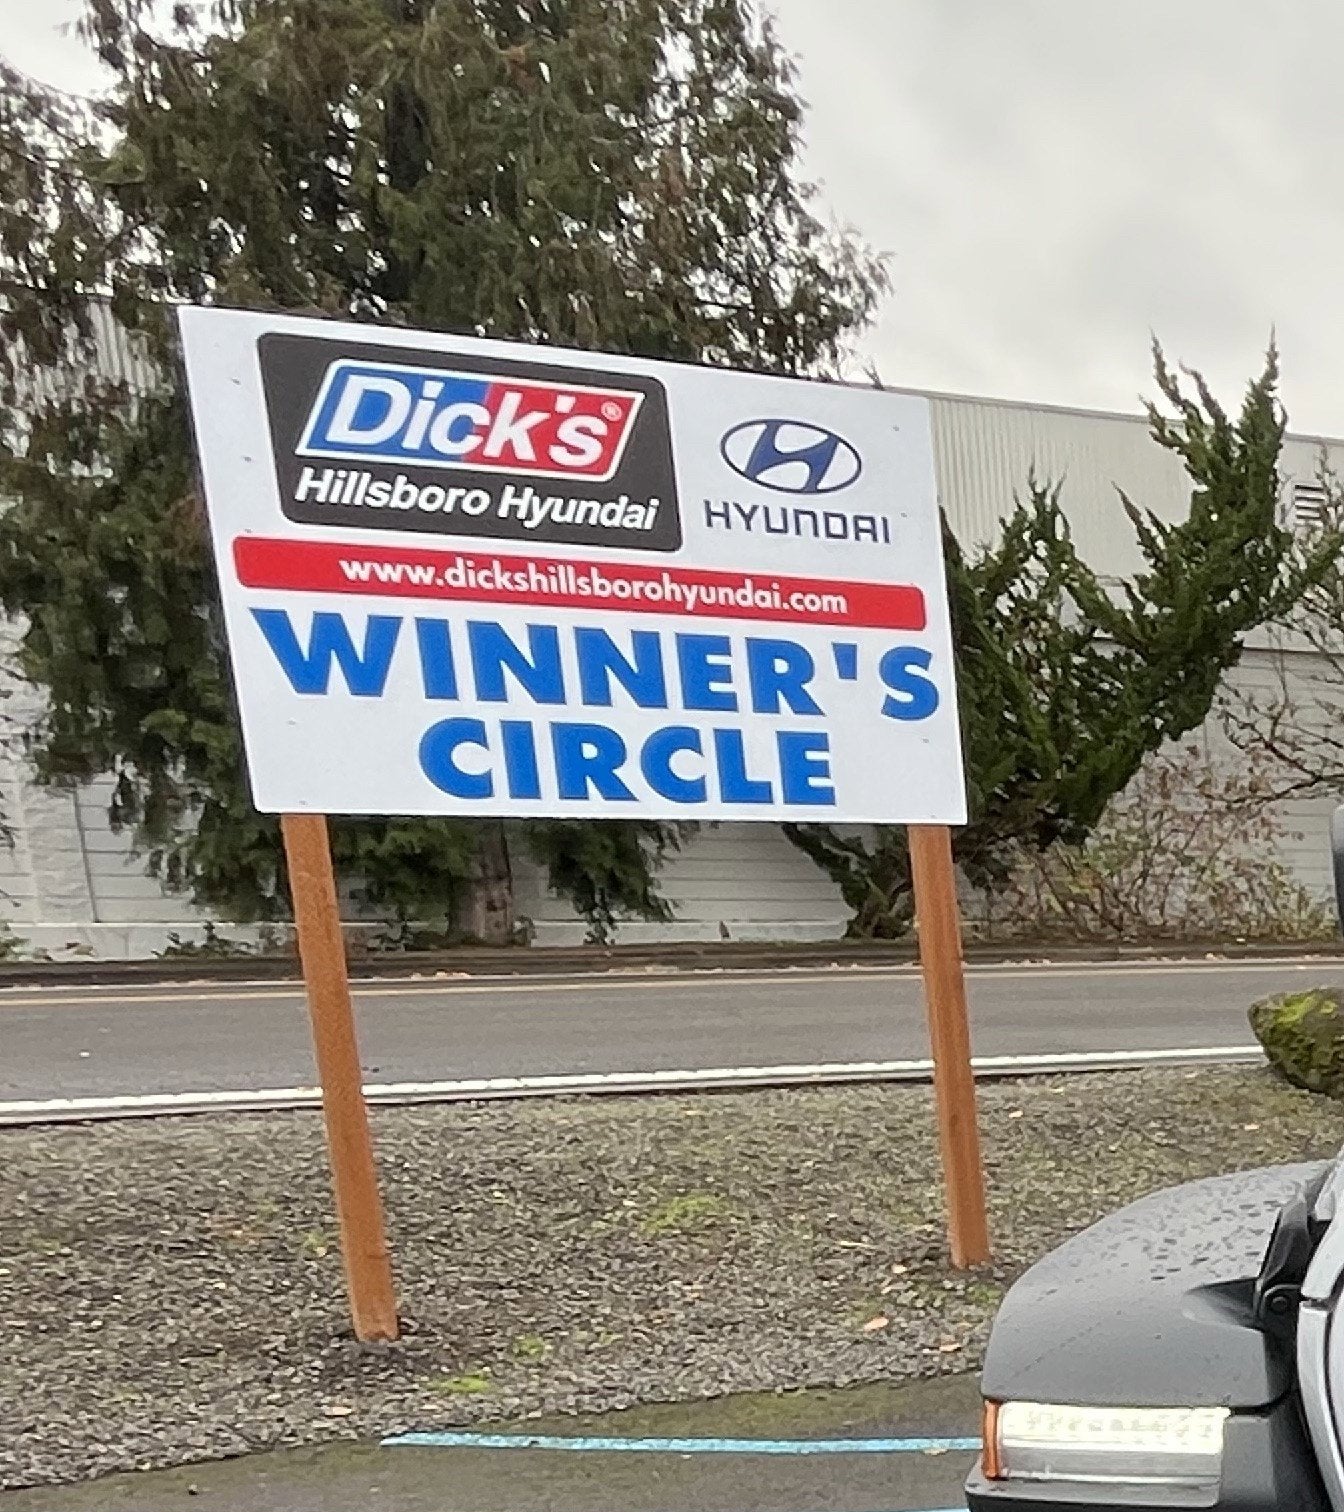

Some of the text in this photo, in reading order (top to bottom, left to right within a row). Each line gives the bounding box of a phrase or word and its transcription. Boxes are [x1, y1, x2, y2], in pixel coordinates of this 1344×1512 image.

[324, 372, 609, 470] Dick's
[294, 466, 661, 532] Hillsboro Hyundai
[703, 498, 891, 545] HYUNDAI
[339, 554, 848, 614] www.dickshillsborohyundai.com
[249, 606, 940, 722] WINNER'S
[418, 715, 836, 806] CIRCLE
